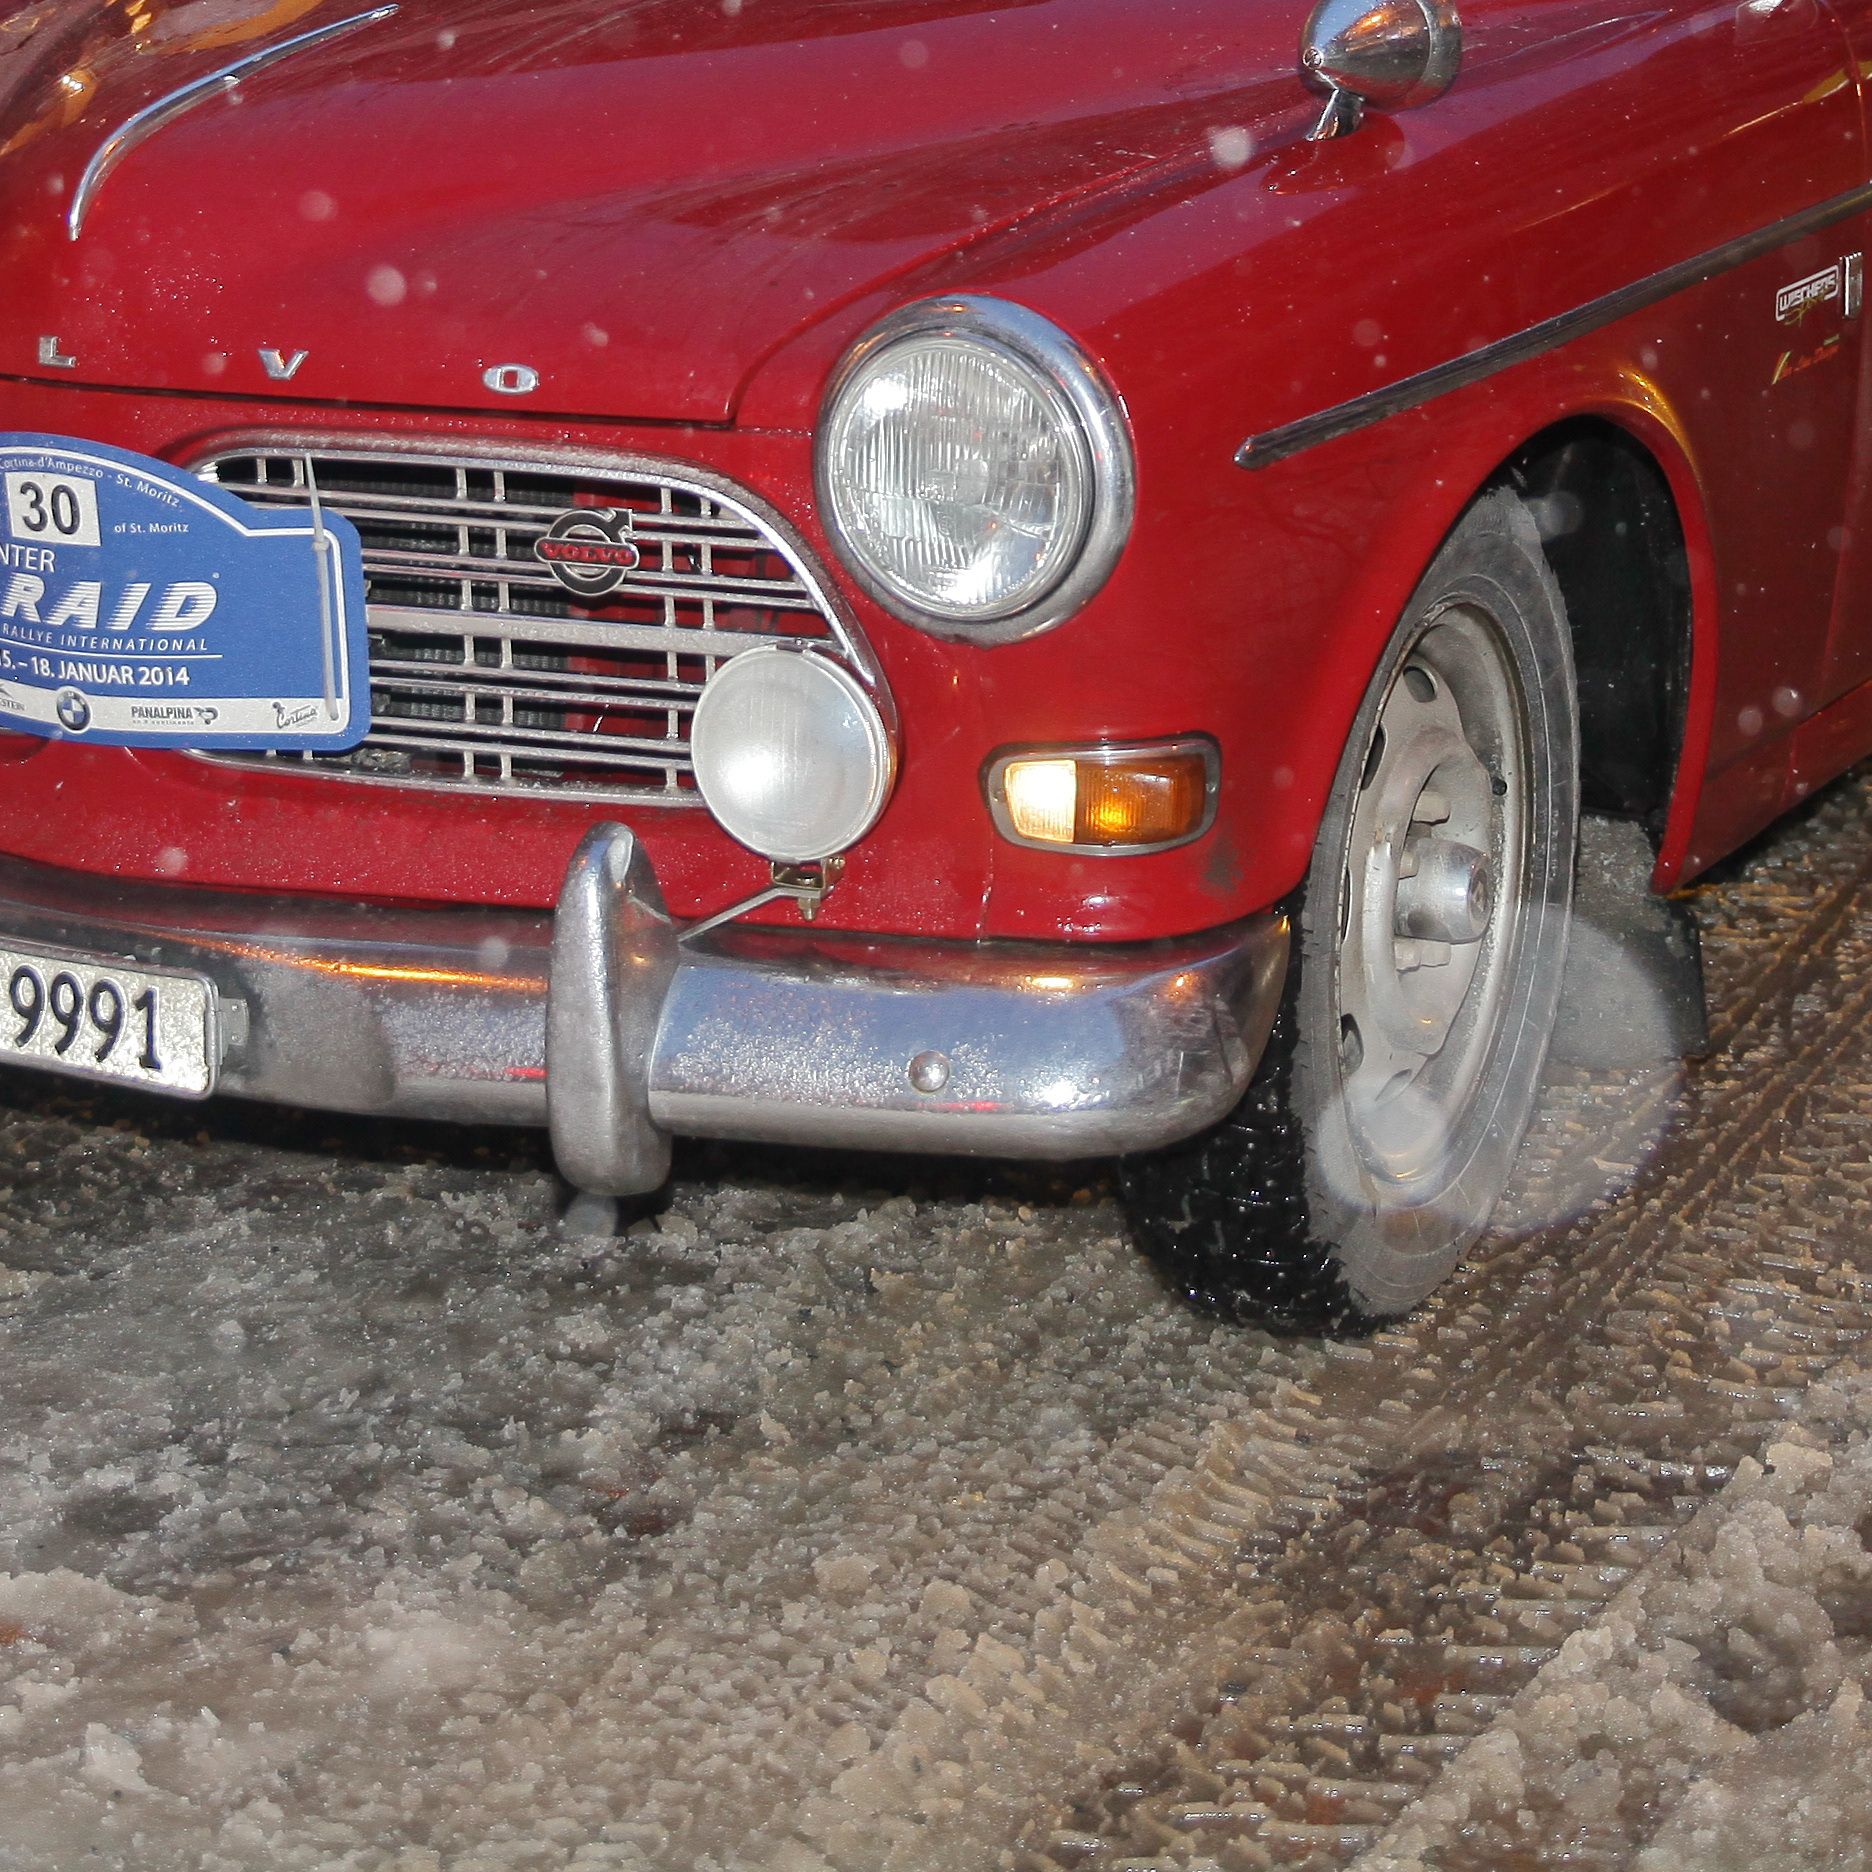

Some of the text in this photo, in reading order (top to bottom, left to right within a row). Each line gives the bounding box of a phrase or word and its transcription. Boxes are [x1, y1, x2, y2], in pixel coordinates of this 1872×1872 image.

[116, 474, 132, 488] St.
[137, 481, 181, 508] Moritz
[19, 481, 80, 535] 30
[130, 523, 146, 533] St.
[149, 523, 189, 533] Moritz
[539, 541, 635, 565] VOLVO
[2, 623, 208, 651] RALLYE INTERNATIONAL
[58, 660, 134, 685] JANUAR
[139, 667, 190, 686] 2014
[131, 706, 194, 719] PANALPINA
